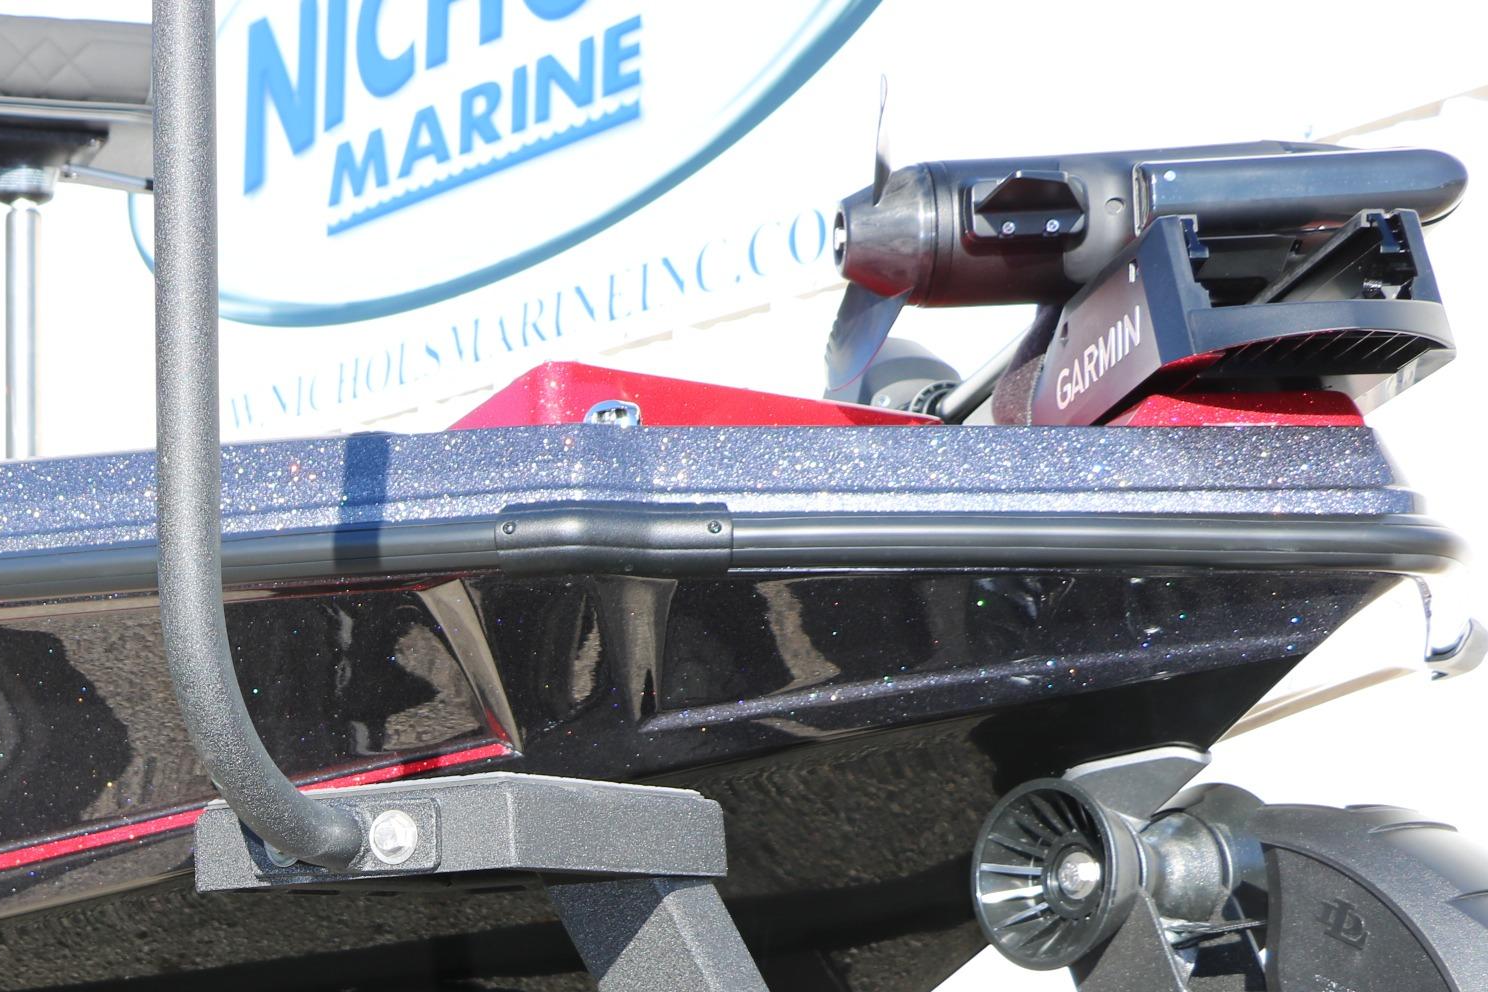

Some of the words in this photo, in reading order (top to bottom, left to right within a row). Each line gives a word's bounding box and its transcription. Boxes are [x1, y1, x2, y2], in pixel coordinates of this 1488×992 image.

[244, 0, 587, 196] NIC
[328, 14, 641, 207] MARINE
[1056, 304, 1141, 410] GARMIN
